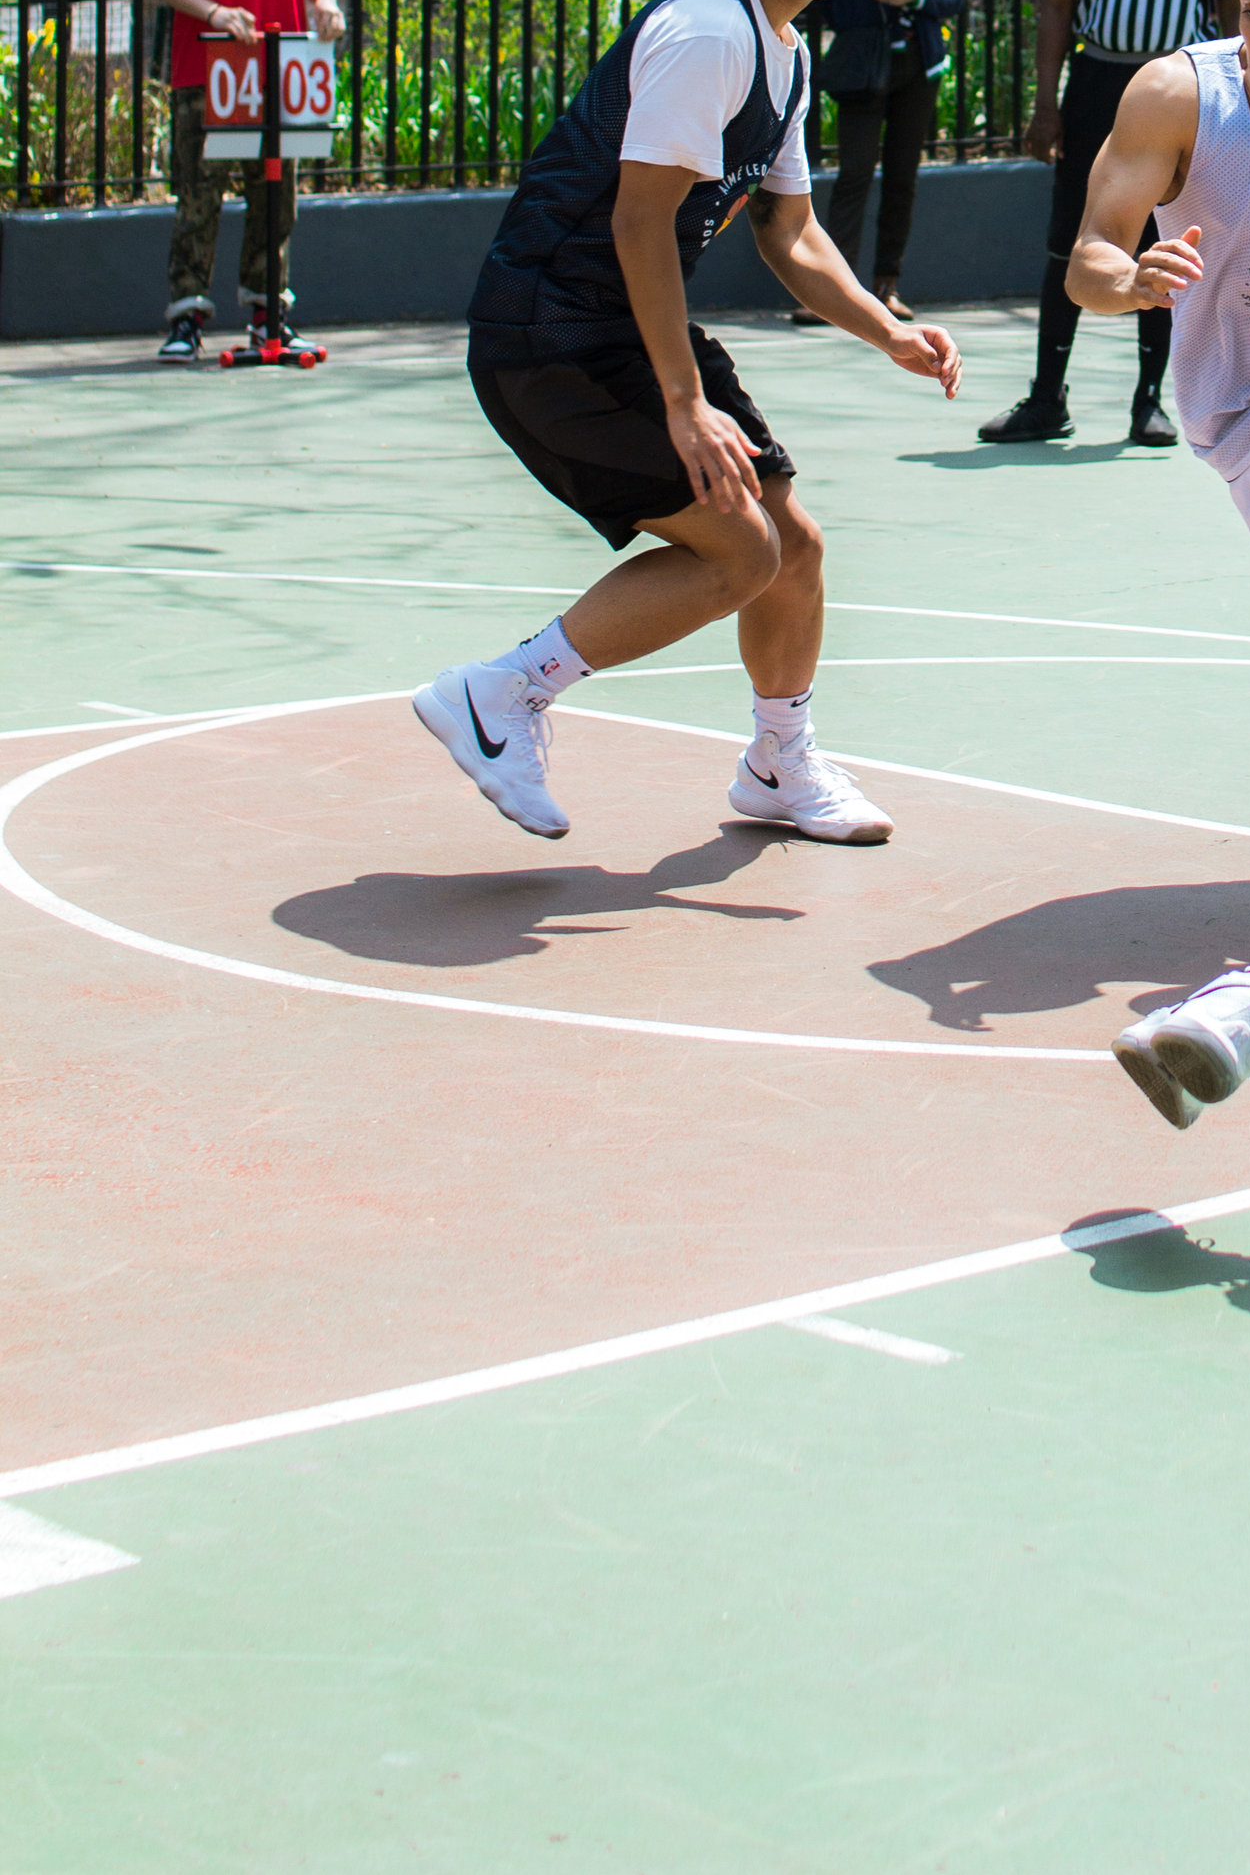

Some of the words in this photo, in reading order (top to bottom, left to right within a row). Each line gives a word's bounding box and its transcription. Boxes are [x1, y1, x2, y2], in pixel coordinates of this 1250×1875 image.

[210, 57, 264, 120] 04
[282, 58, 332, 116] 03
[745, 163, 767, 176] LEO
